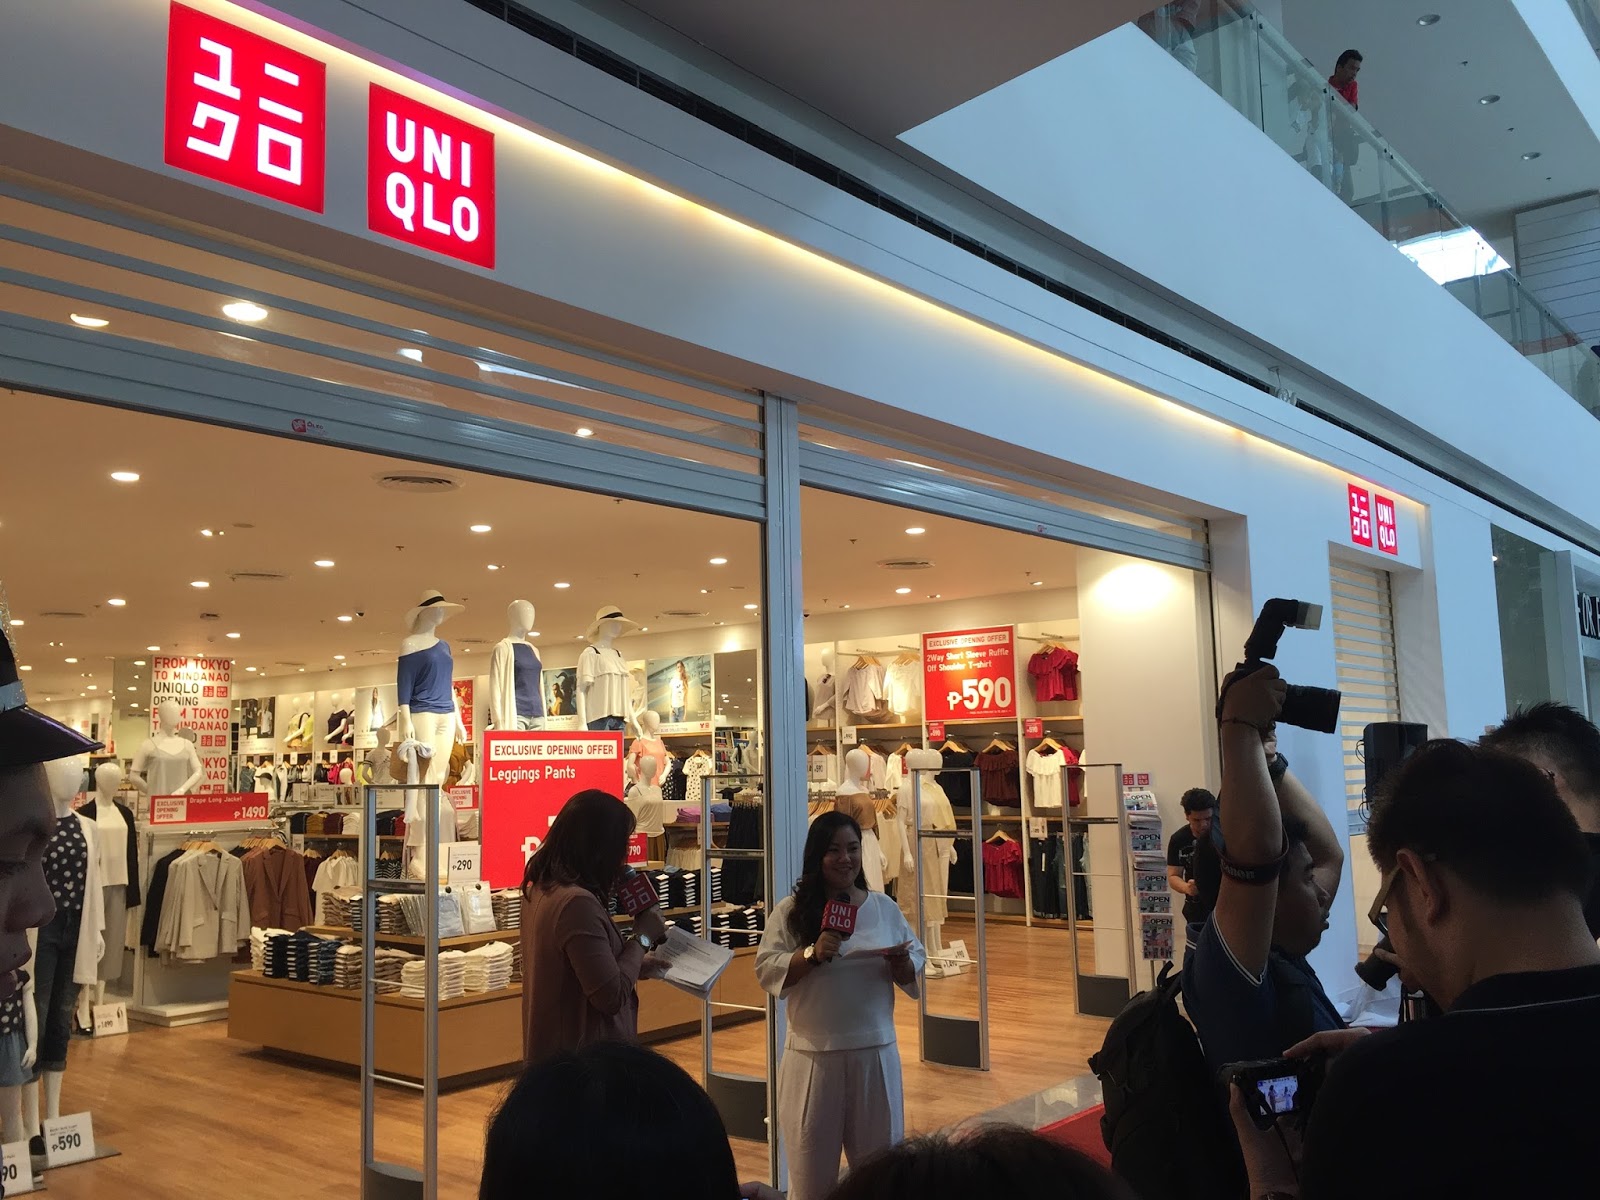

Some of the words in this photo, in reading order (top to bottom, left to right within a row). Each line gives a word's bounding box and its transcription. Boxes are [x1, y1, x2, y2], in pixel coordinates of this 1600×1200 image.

[386, 110, 471, 188] UNI
[386, 171, 479, 242] QLO
[1377, 503, 1393, 526] UNI
[1379, 525, 1396, 548] QLO
[929, 638, 958, 648] EXCLUSIVE
[987, 634, 1007, 642] OFFER
[927, 654, 944, 662] 2Way
[946, 651, 964, 660] Short
[966, 650, 986, 659] Sleeve
[989, 648, 1009, 657] Ruffle
[154, 657, 188, 669] FROM
[193, 658, 230, 670] TOKYO
[927, 664, 937, 672] Off
[939, 662, 966, 671] Shoulder
[968, 660, 992, 669] T-shirt
[154, 671, 168, 680] TO
[173, 671, 230, 682] MINDANAO
[153, 682, 199, 695] UNIQLO
[192, 708, 229, 719] TOKYO
[494, 745, 543, 756] EXCLUSIVE
[547, 744, 584, 755] OPENING
[587, 744, 614, 755] OFFER
[489, 766, 540, 784] Leggings
[544, 765, 576, 779] Pants
[831, 904, 851, 917] UNI
[829, 915, 851, 928] QLO
